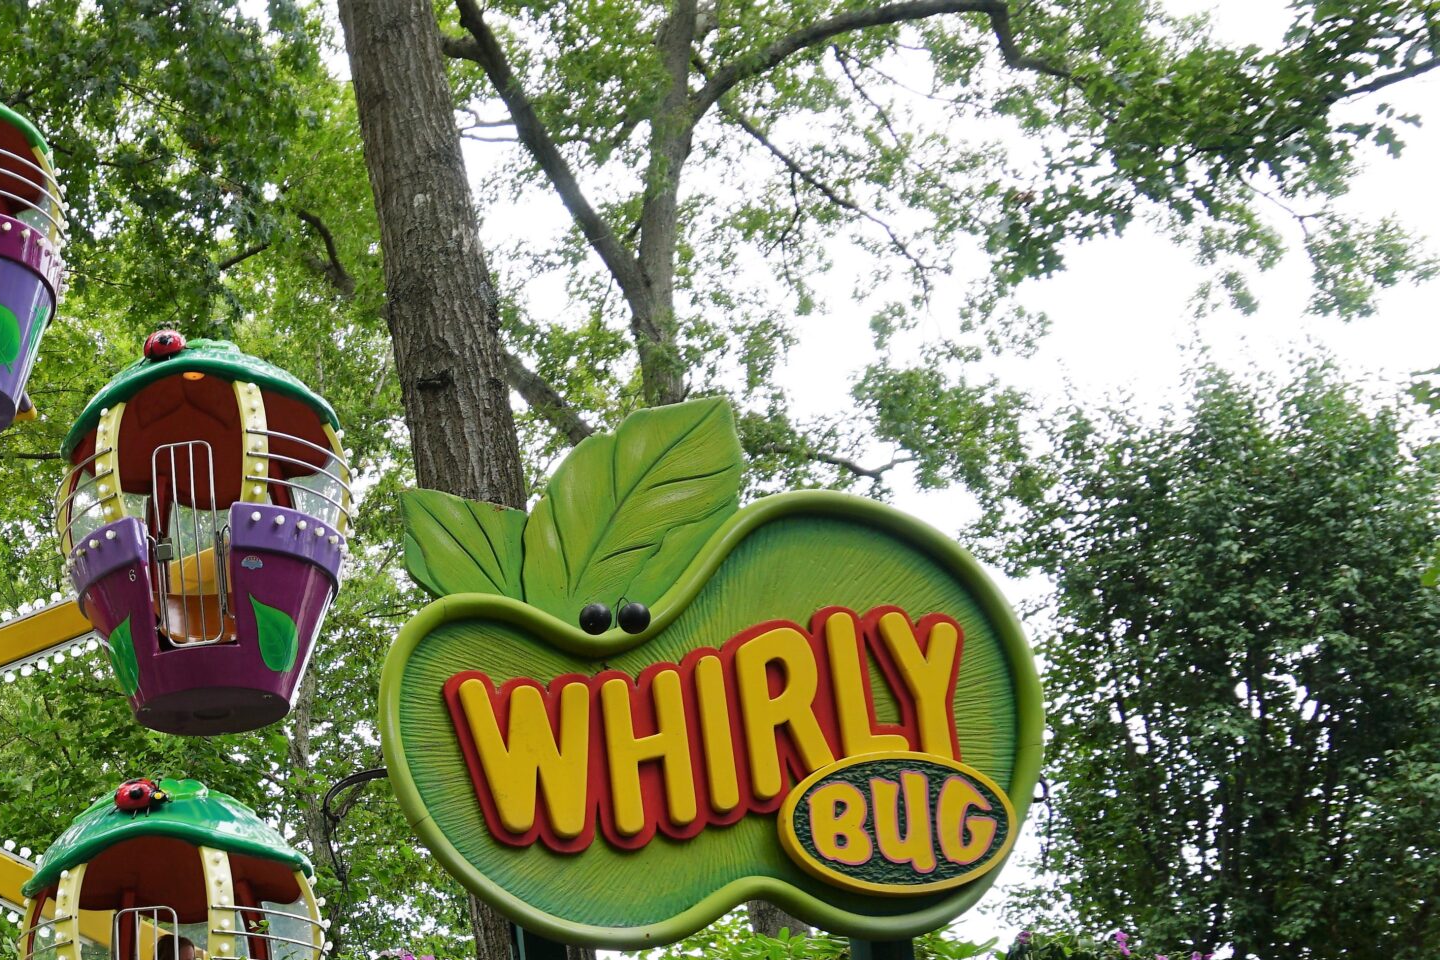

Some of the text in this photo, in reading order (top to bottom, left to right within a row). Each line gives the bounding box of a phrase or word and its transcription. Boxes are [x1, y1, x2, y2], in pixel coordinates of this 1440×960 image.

[128, 569, 137, 582] 6
[453, 609, 962, 843] WHIRLY
[807, 770, 998, 874] BUG
